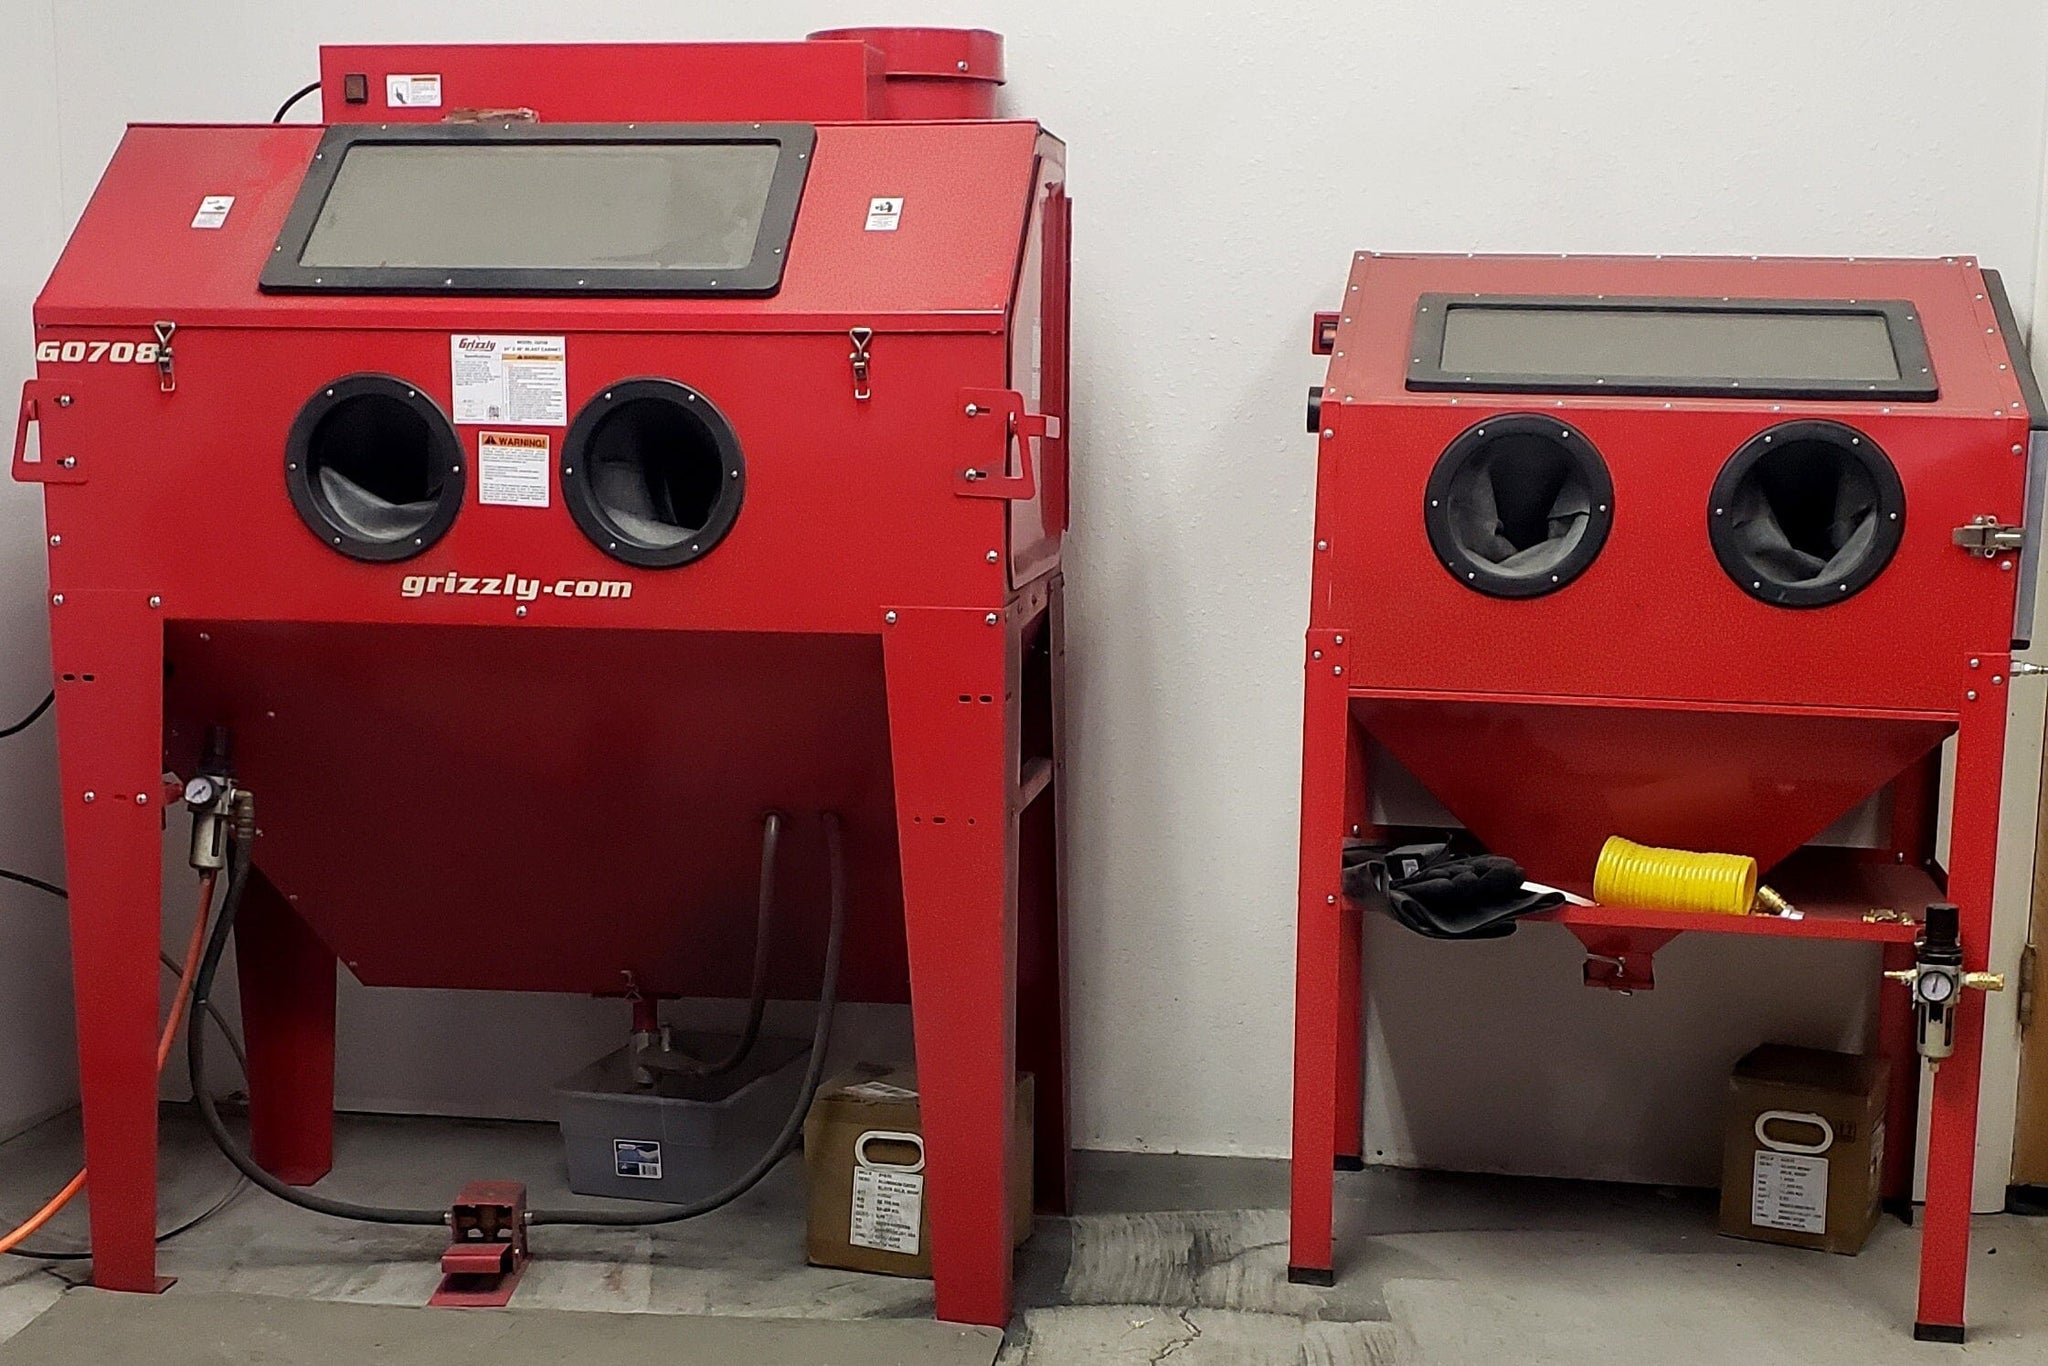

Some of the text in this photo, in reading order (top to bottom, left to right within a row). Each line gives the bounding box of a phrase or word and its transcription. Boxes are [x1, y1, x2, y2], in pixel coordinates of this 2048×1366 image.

[36, 341, 160, 364] G0708
[459, 338, 496, 352] Grizzly
[498, 437, 546, 449] WARNING!
[401, 571, 633, 601] grizzly.com
